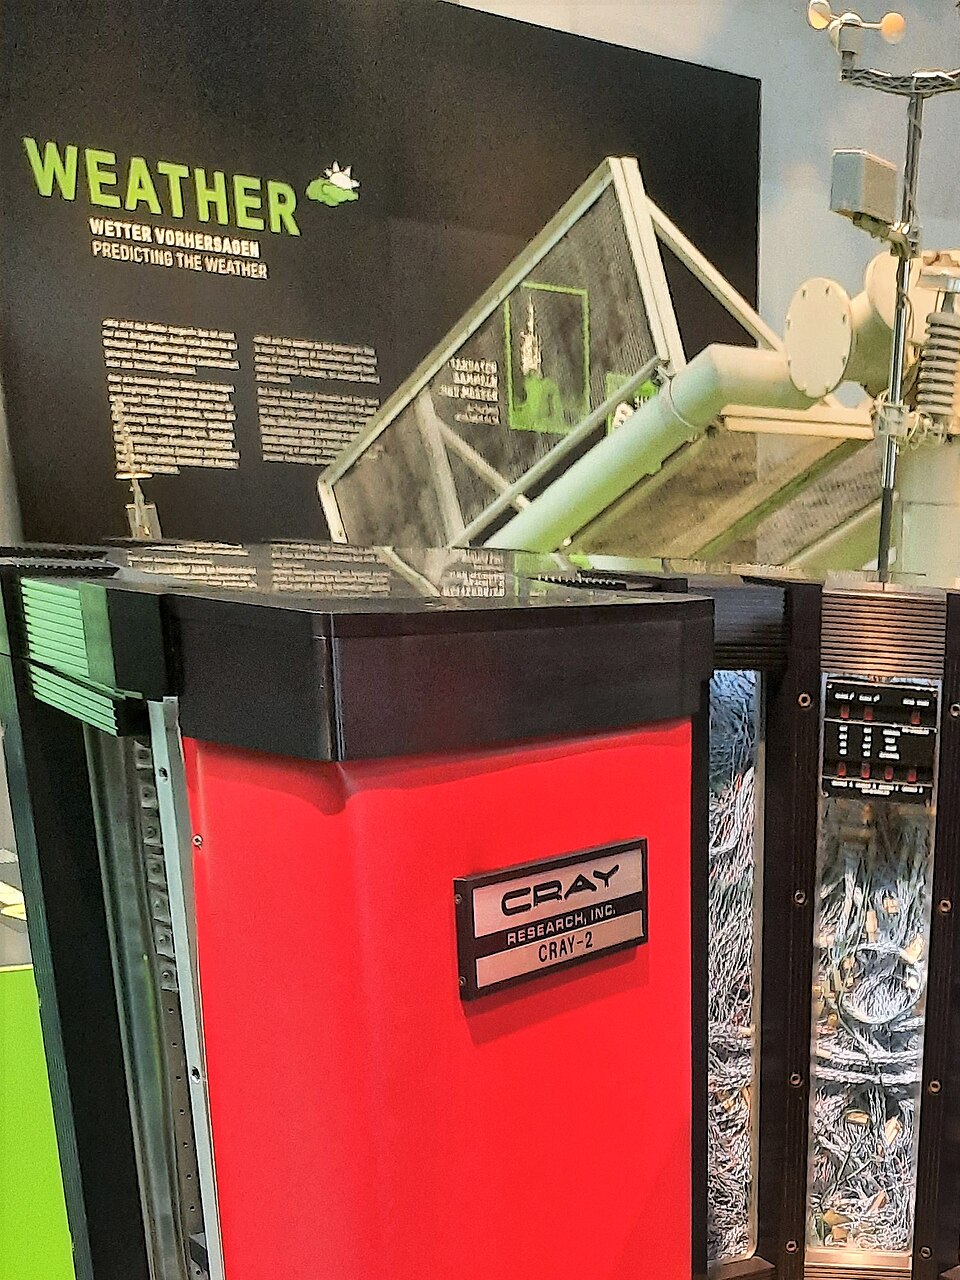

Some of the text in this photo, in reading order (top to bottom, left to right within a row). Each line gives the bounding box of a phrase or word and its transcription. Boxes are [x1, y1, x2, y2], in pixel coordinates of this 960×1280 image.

[22, 136, 300, 236] WEATHER
[89, 217, 153, 243] WETTER
[92, 240, 268, 279] PREDICTING THE WEATHER
[501, 864, 620, 916] CRAY
[507, 904, 616, 945] RESEARCH, INC.
[538, 931, 593, 963] CRAY-2
